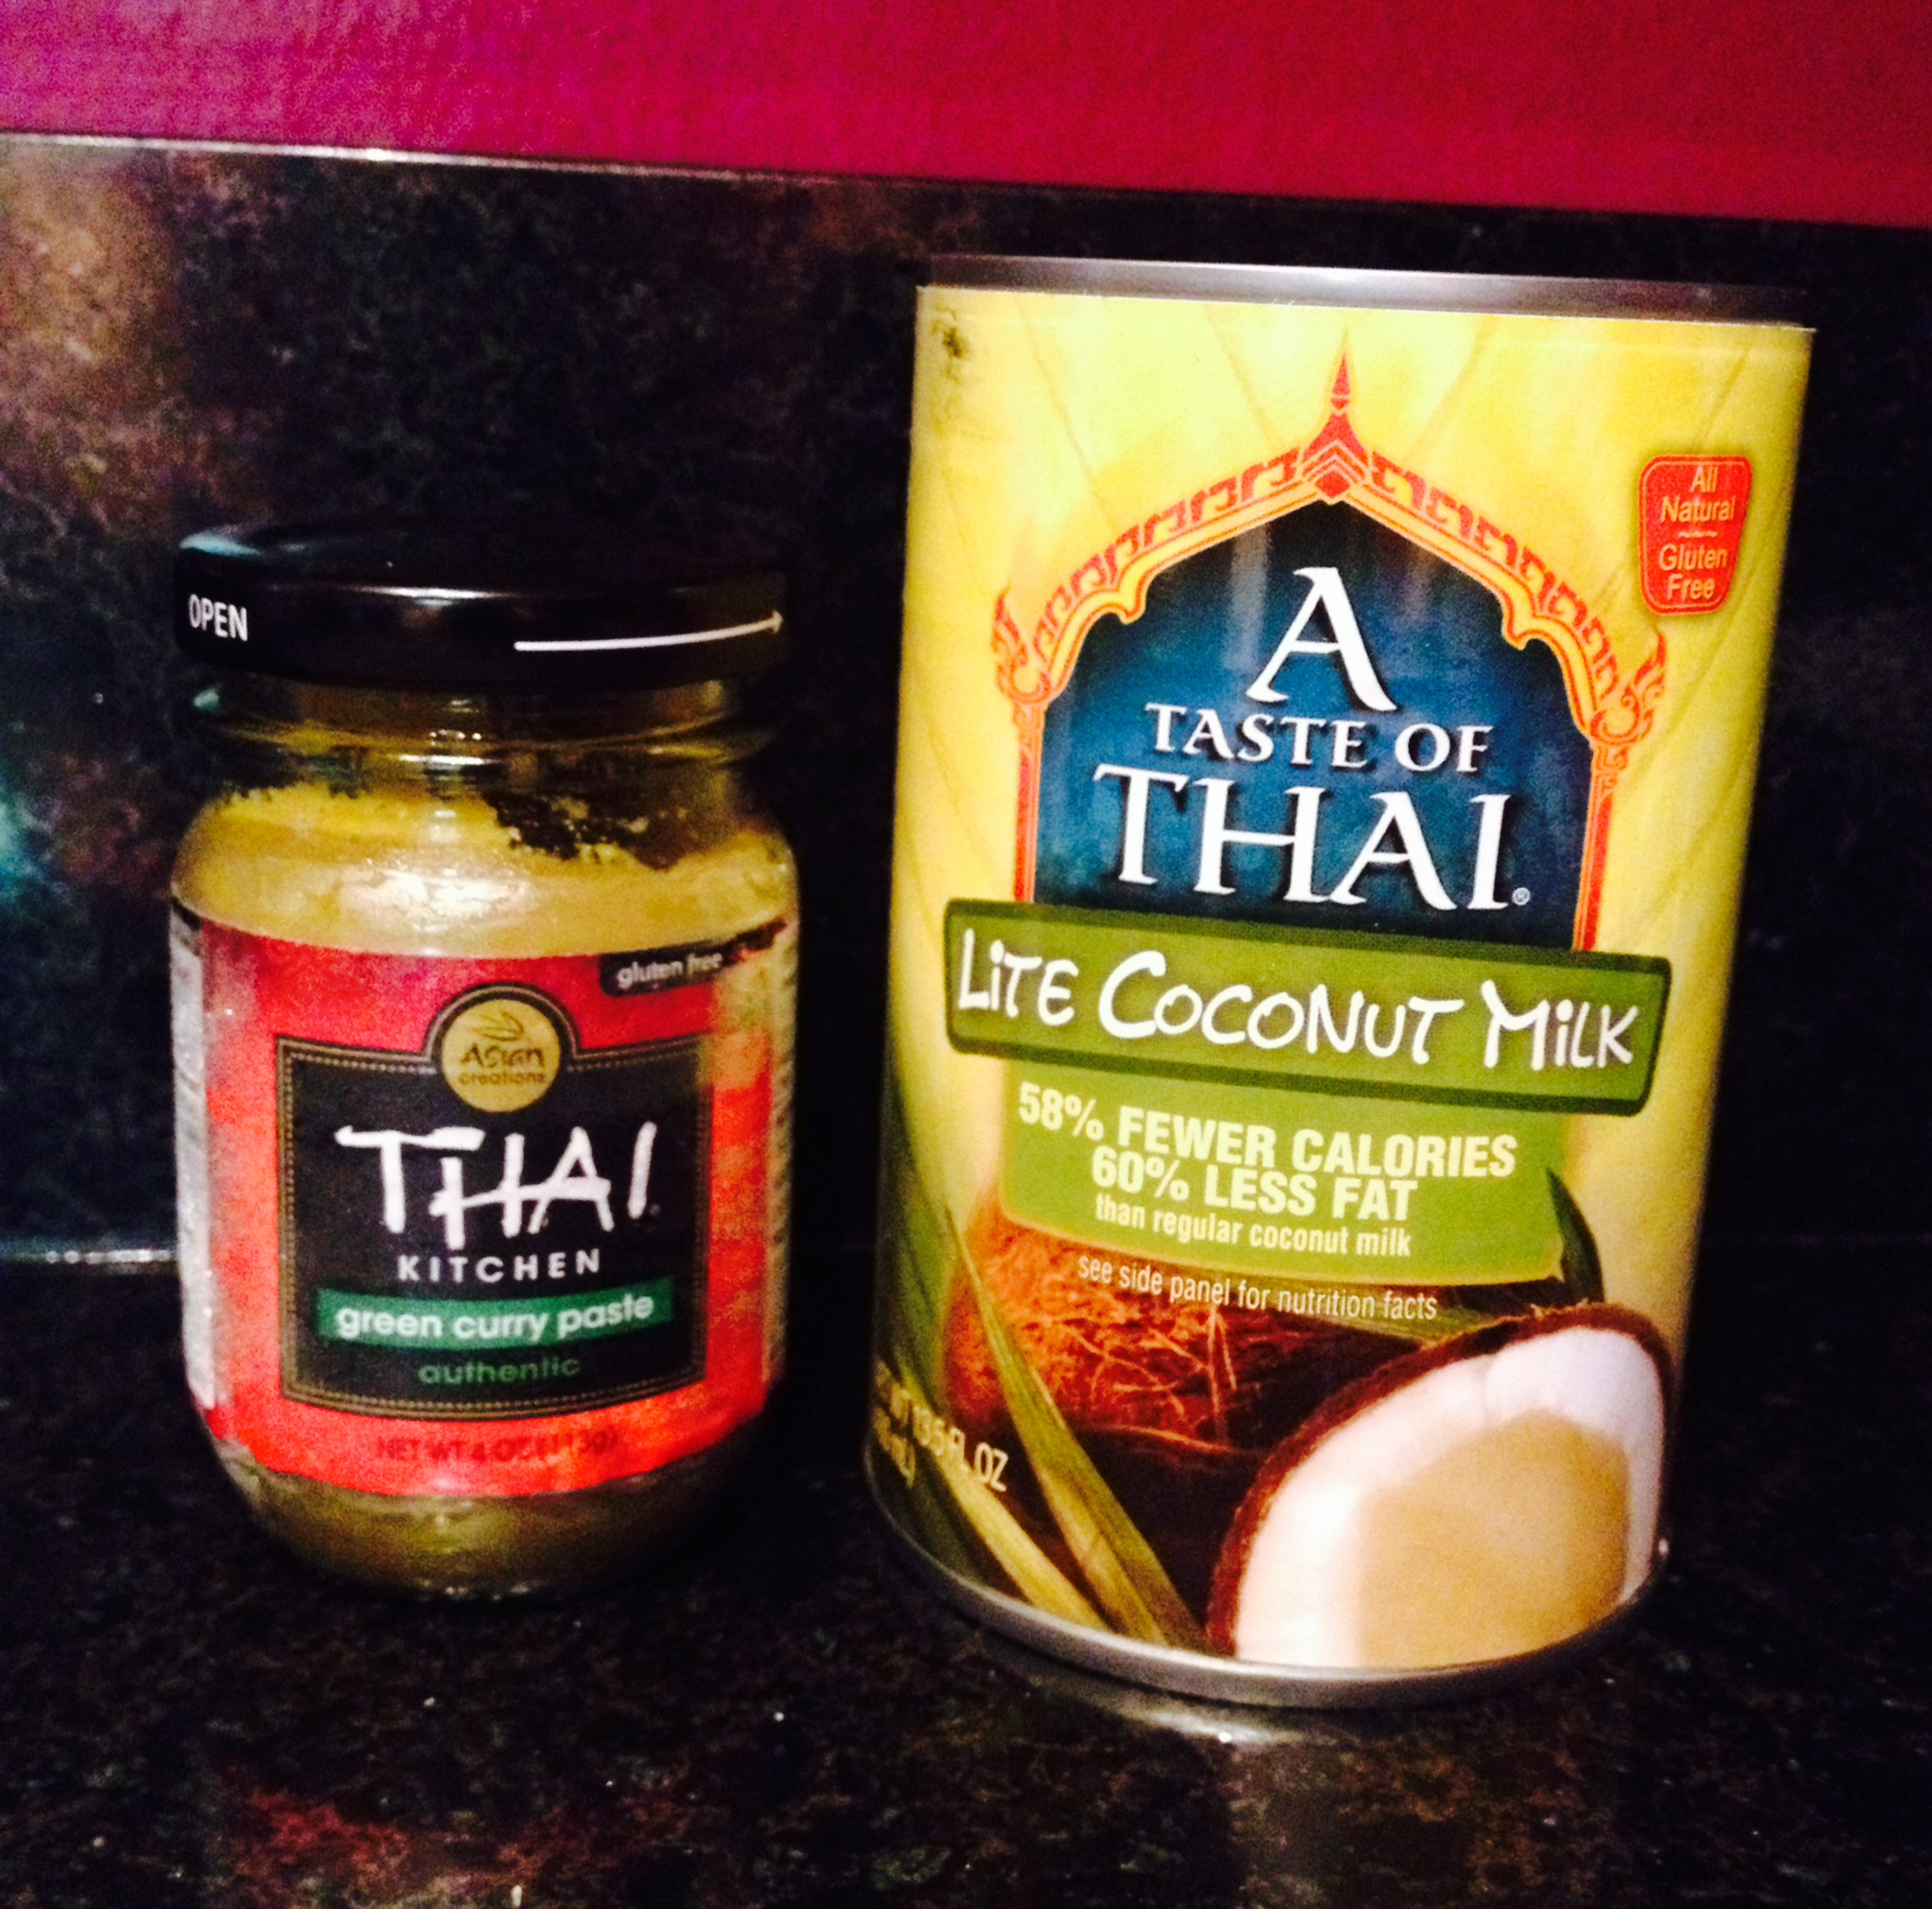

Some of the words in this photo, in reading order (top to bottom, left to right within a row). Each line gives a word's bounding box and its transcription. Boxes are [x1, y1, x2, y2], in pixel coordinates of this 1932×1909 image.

[1689, 465, 1719, 493] All
[1660, 495, 1737, 523] Natural
[1659, 543, 1729, 571] Gluten
[1667, 573, 1717, 600] Free
[190, 594, 249, 642] OPEN
[1245, 566, 1398, 711] A
[1144, 702, 1367, 769] TASTE
[1394, 723, 1494, 773] OF
[1093, 763, 1513, 911] THAI
[617, 961, 685, 989] gluten
[686, 953, 724, 977] free
[459, 1073, 545, 1087] creations
[1018, 1082, 1105, 1141] 58%
[1117, 1105, 1276, 1169] FEWER
[1292, 1128, 1518, 1178] CALORIES
[333, 1121, 657, 1251] THAI
[1092, 1145, 1190, 1202] 60%
[1204, 1164, 1316, 1216] LESS
[1332, 1176, 1418, 1222] FAT
[1094, 1193, 1145, 1230] than
[1152, 1209, 1242, 1244] regular
[1248, 1222, 1348, 1257] coconut
[1355, 1226, 1412, 1258] milk
[397, 1248, 601, 1283] KITCHEN
[1077, 1255, 1112, 1285] see
[1119, 1262, 1163, 1295] side
[1169, 1274, 1230, 1307] panel
[1237, 1279, 1272, 1311] for
[1278, 1286, 1376, 1319] nutrition
[1382, 1290, 1438, 1321] facts
[335, 1308, 444, 1340] green
[451, 1311, 551, 1342] curry
[555, 1293, 654, 1339] paste
[418, 1357, 581, 1384] authentic
[974, 1442, 1008, 1493] OZ
